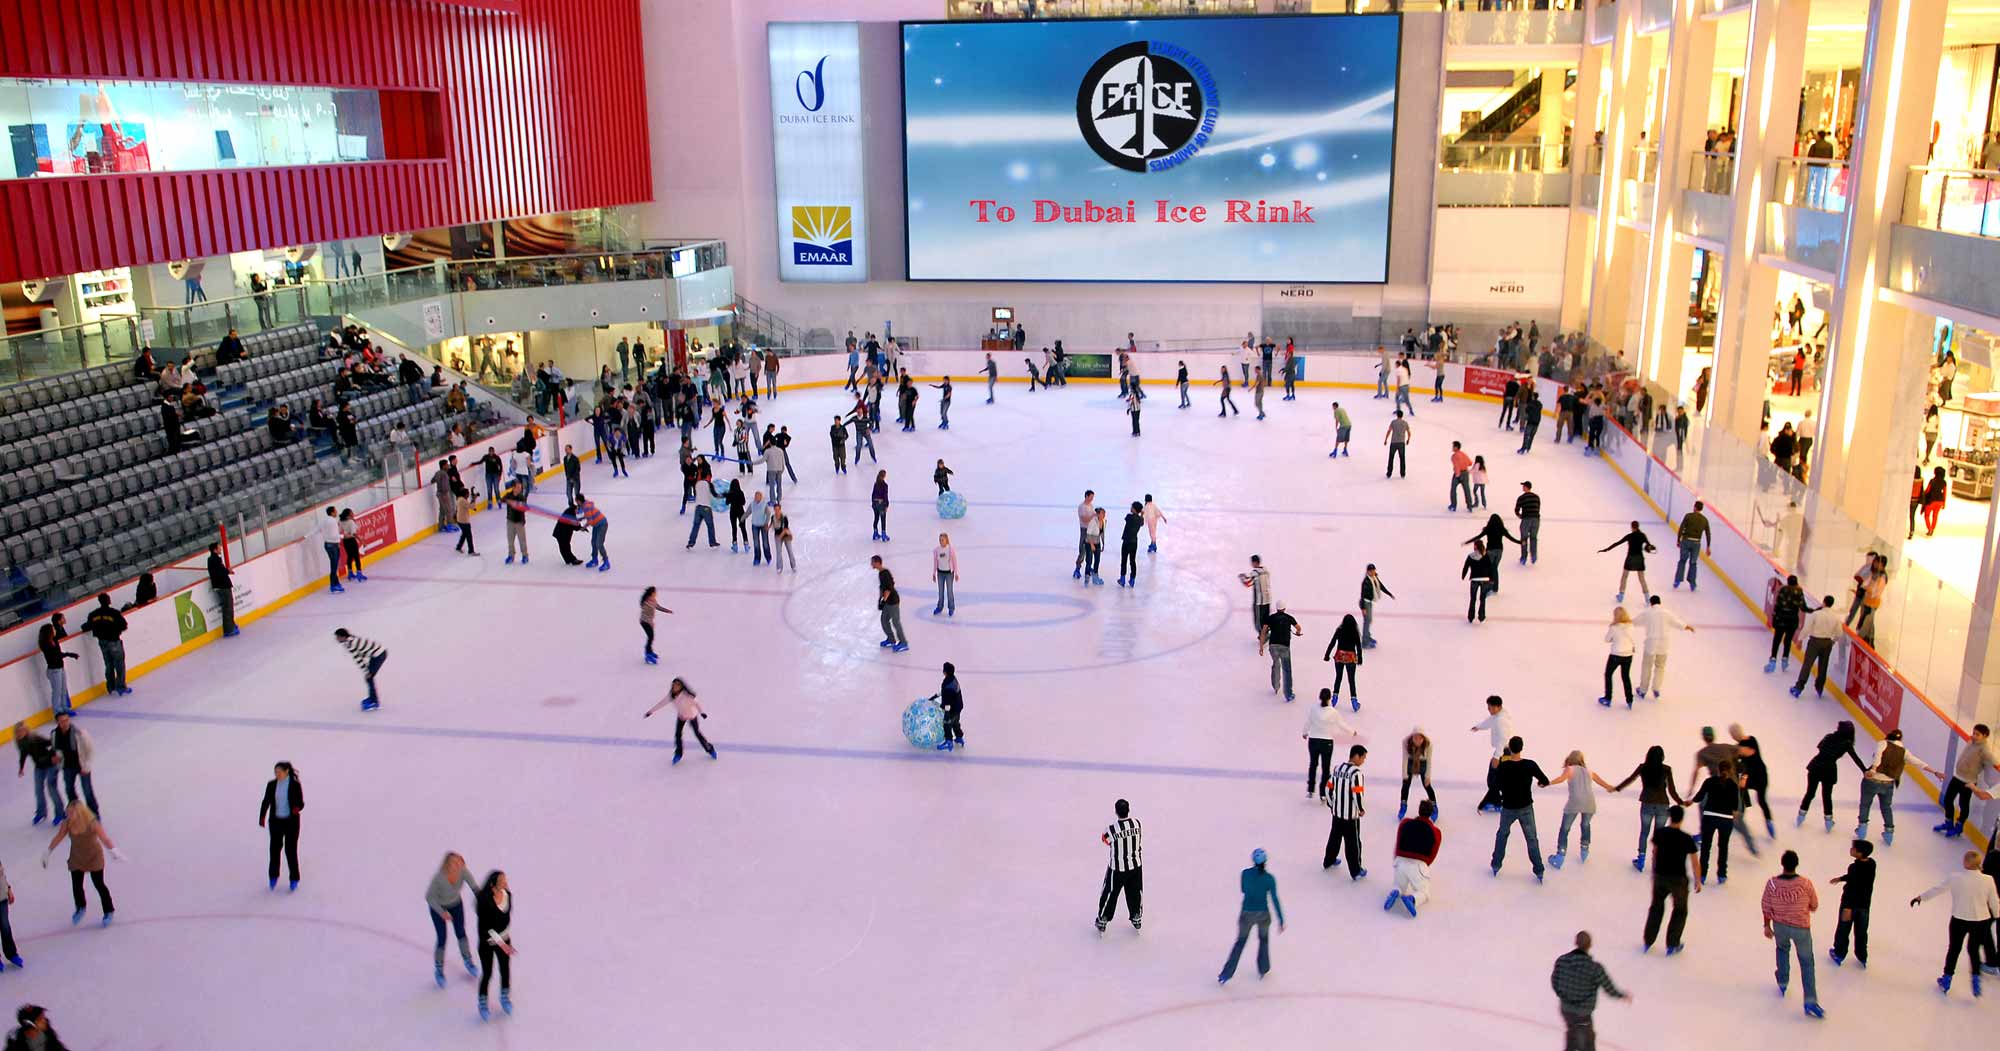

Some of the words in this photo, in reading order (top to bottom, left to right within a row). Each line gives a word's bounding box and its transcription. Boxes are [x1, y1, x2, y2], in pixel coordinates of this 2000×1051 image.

[1102, 82, 1192, 111] FACE
[780, 114, 809, 124] DUBAI
[812, 114, 829, 124] ICE
[831, 114, 855, 124] RINK
[1200, 108, 1218, 133] CLUB
[1194, 132, 1209, 148] OF
[1149, 143, 1199, 172] EMIRATES
[970, 200, 1016, 223] To
[1033, 200, 1137, 223] Dubai
[1155, 200, 1207, 223] Ice
[1225, 199, 1315, 223] Rink
[800, 251, 848, 263] EMAAR
[1281, 289, 1314, 297] NERO
[1490, 284, 1524, 293] NERO
